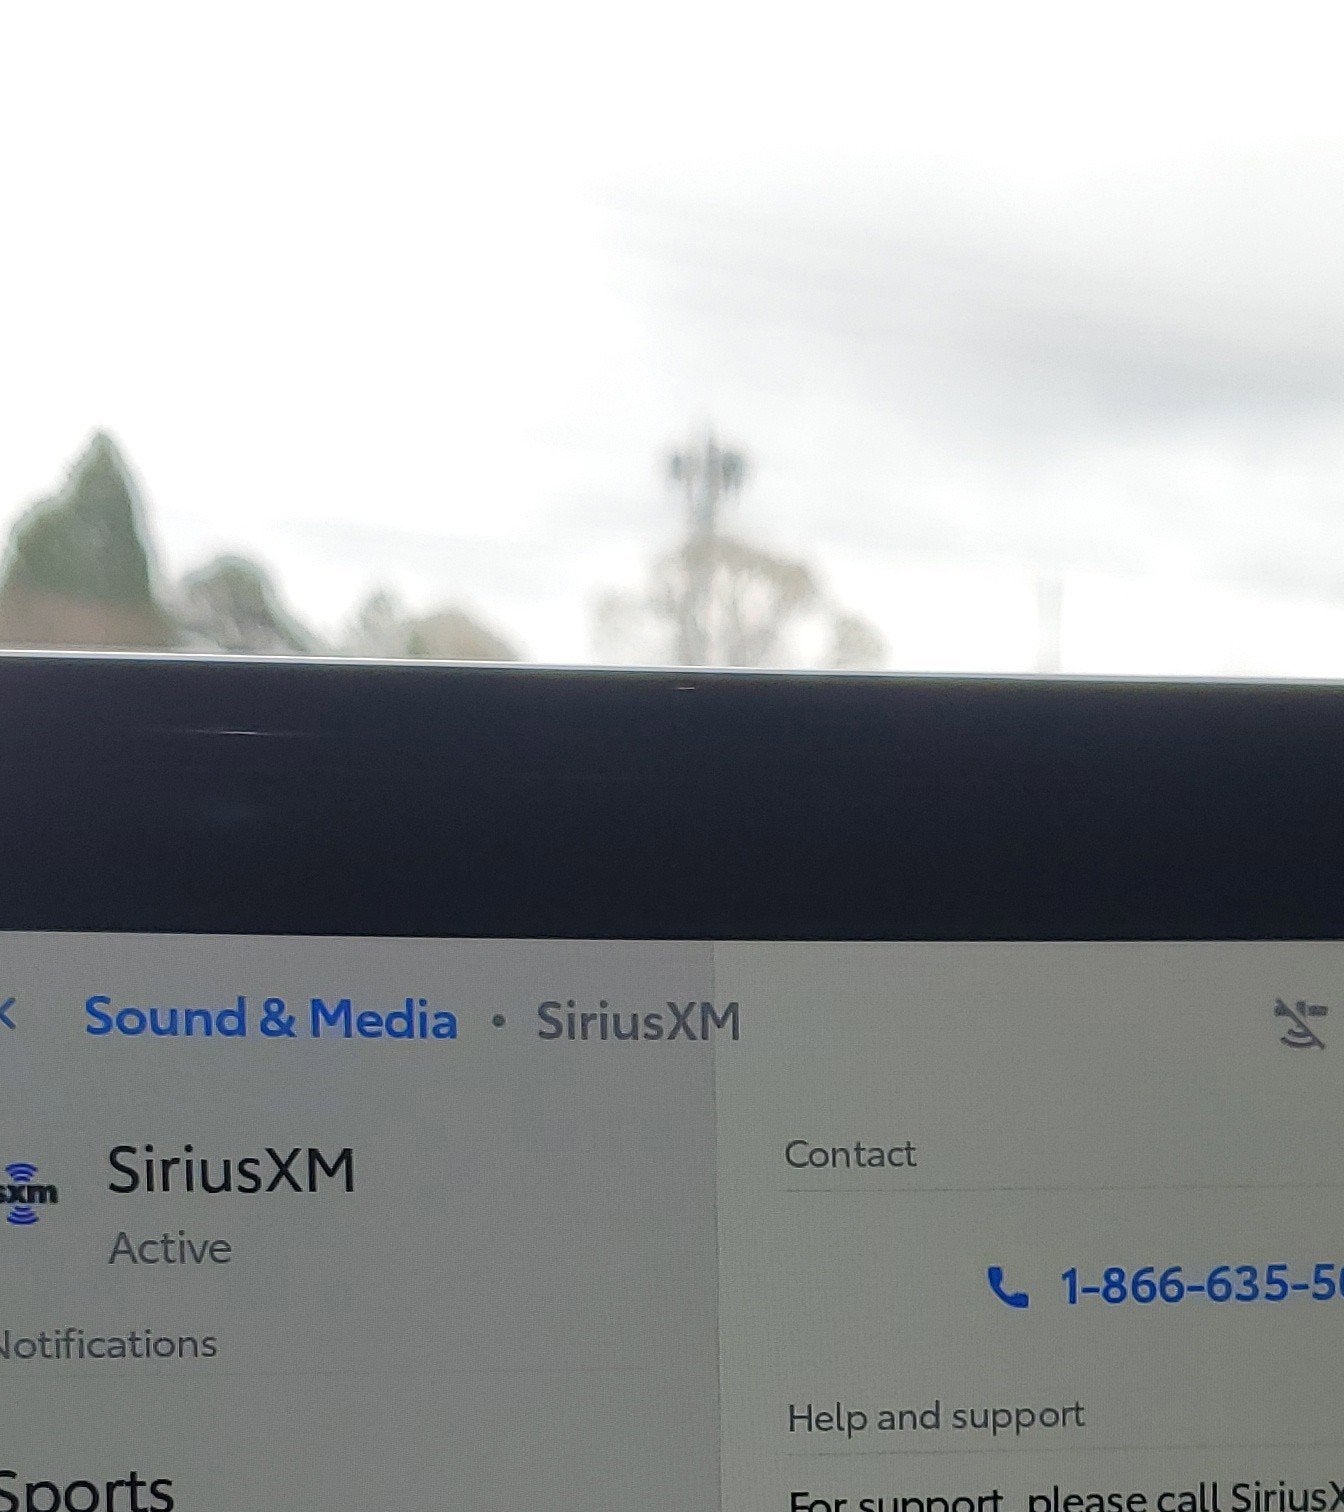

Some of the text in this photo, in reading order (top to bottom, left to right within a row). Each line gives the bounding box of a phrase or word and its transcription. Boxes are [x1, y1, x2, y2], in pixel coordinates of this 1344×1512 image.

[86, 996, 739, 1040] Sound & Media SiriusXM
[109, 1144, 353, 1193] SiriusXM
[785, 1140, 917, 1168] Contact
[108, 1230, 231, 1264] Active
[789, 1400, 1085, 1440] Help and support
